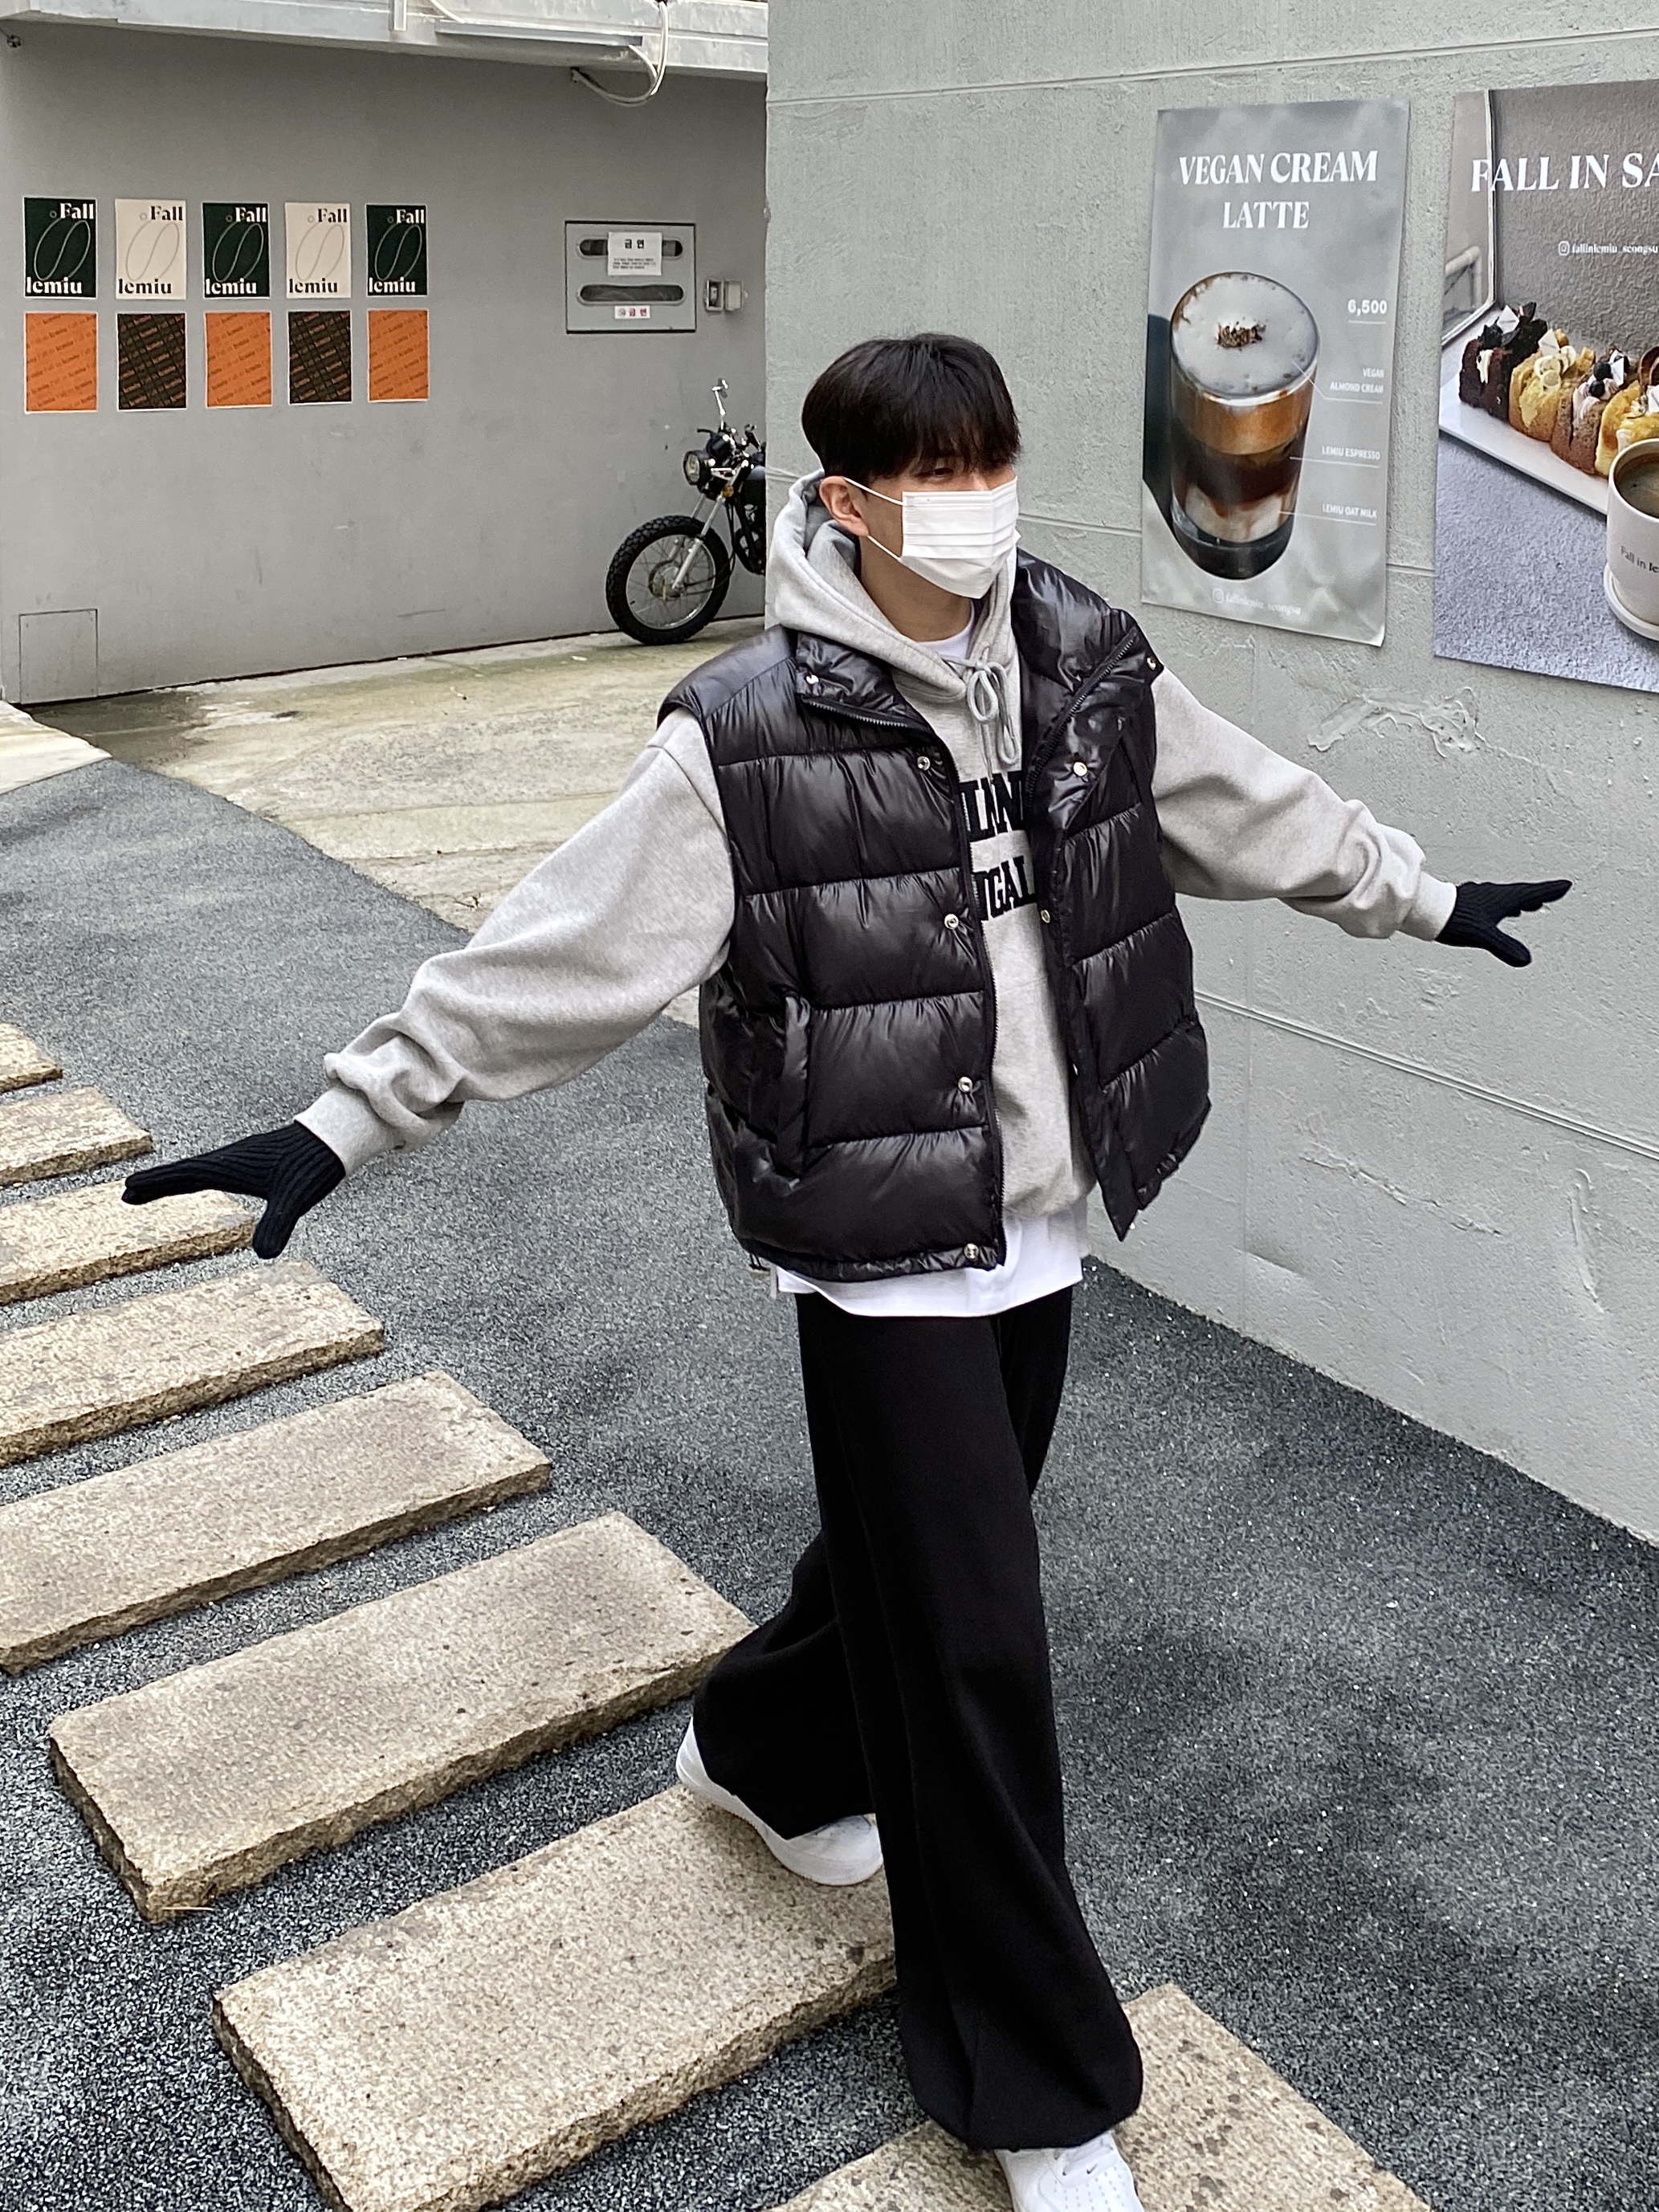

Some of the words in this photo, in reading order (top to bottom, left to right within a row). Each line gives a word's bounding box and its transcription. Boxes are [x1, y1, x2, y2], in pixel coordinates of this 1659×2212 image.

[1179, 153, 1265, 185] VEGAN
[1270, 150, 1378, 183] CREAM
[1471, 157, 1559, 192] FALL
[1569, 153, 1609, 189] IN
[59, 202, 95, 220] Fall
[150, 206, 184, 222] Fall
[234, 206, 267, 223] Fall
[317, 208, 348, 223] Fall
[396, 208, 425, 224] Fall
[1223, 201, 1310, 230] LATTE
[26, 277, 83, 295] lemiu
[118, 278, 173, 295] lemiu
[205, 278, 258, 295] lemiu
[289, 277, 338, 294] lemiu
[369, 277, 416, 294] lemiu
[1347, 299, 1388, 317] 6,500
[1363, 368, 1384, 378] VEGAN
[1330, 381, 1360, 393] ALMOND
[1361, 383, 1384, 393] CREAM
[1322, 446, 1344, 457] LEMIU
[1345, 449, 1380, 460] ESPRESSO
[1322, 503, 1343, 515] LEMIU
[1344, 506, 1359, 516] OAT
[1359, 507, 1377, 519] MILK
[1620, 545, 1635, 564] Fall
[1637, 557, 1646, 569] in
